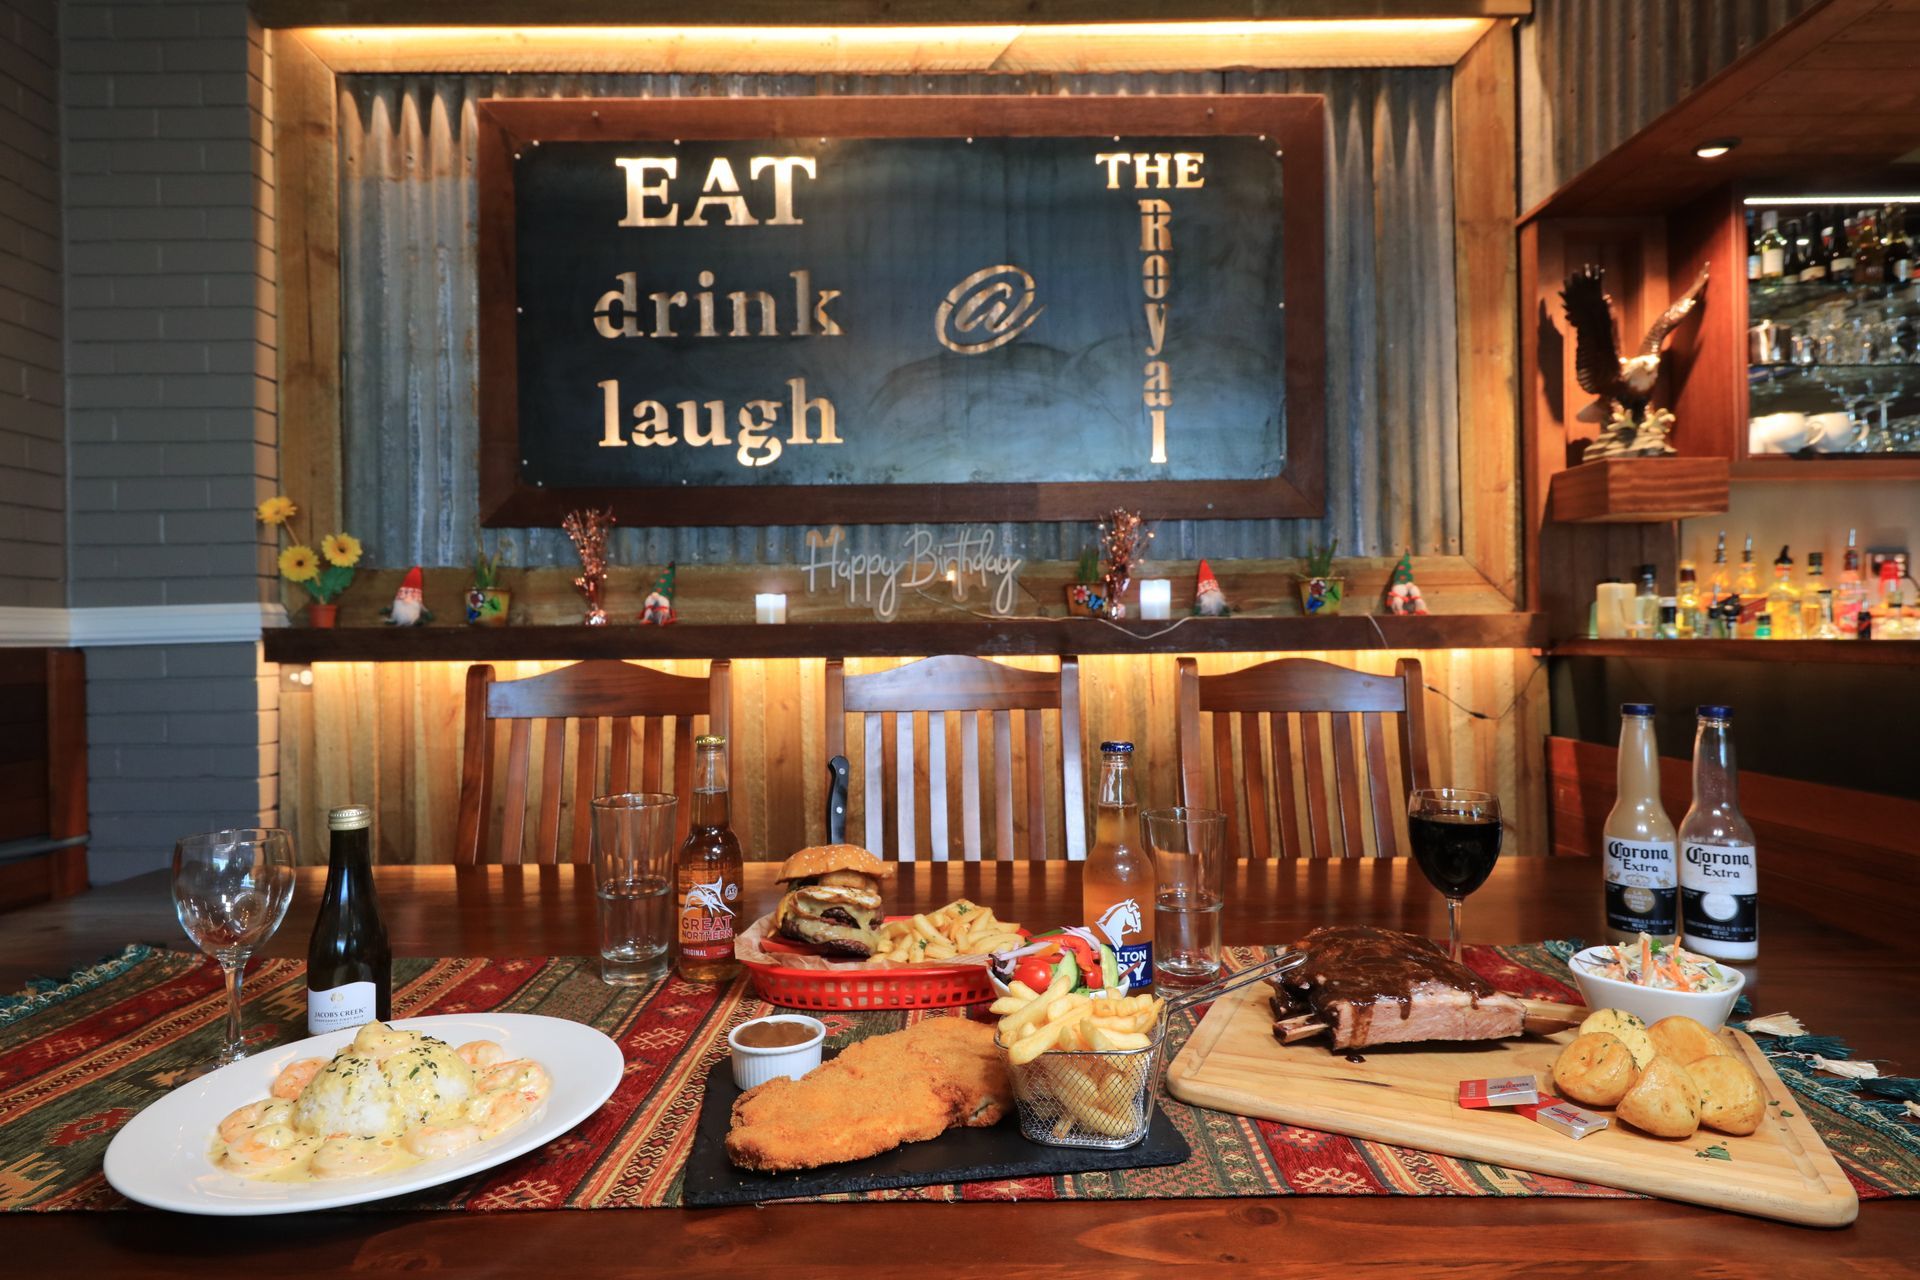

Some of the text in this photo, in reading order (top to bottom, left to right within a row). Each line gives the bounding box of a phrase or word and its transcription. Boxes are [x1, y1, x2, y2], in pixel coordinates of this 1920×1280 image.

[1095, 153, 1204, 188] THE
[615, 156, 817, 227] EAT
[593, 270, 846, 338] drink
[935, 265, 1047, 354] @
[597, 377, 844, 467] laugh
[801, 527, 1022, 616] Happy Birthday
[1608, 841, 1671, 861] Corona
[1686, 847, 1752, 867] Corona
[1623, 858, 1659, 872] Extra
[1703, 864, 1740, 878] Extra
[681, 915, 732, 931] GREAT
[682, 928, 733, 941] NORTHERN
[1113, 949, 1147, 962] LTON
